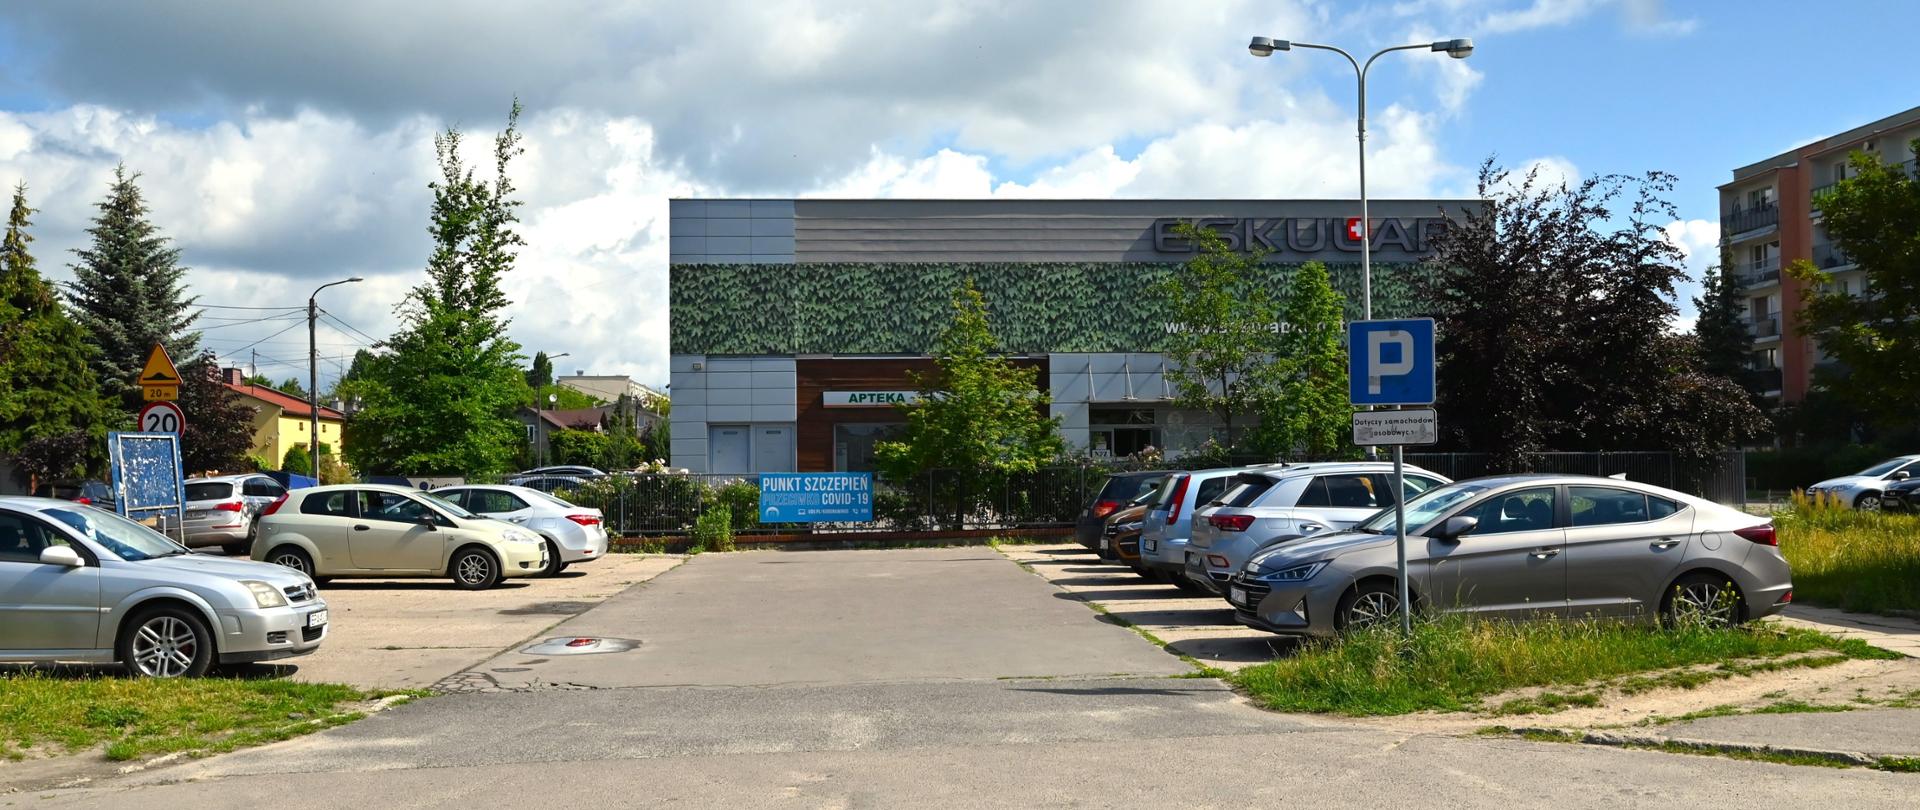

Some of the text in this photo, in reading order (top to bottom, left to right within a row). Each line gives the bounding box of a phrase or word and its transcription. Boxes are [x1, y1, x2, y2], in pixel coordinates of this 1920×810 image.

[1154, 217, 1455, 252] ESKULAP
[1368, 330, 1413, 394] P
[150, 389, 162, 398] 20
[848, 393, 905, 403] APTEKA
[147, 413, 177, 433] 20
[1354, 419, 1382, 427] Dotyczy
[763, 474, 868, 491] PUNKT SZCZEPIEŃ
[822, 492, 869, 505] COVID-19
